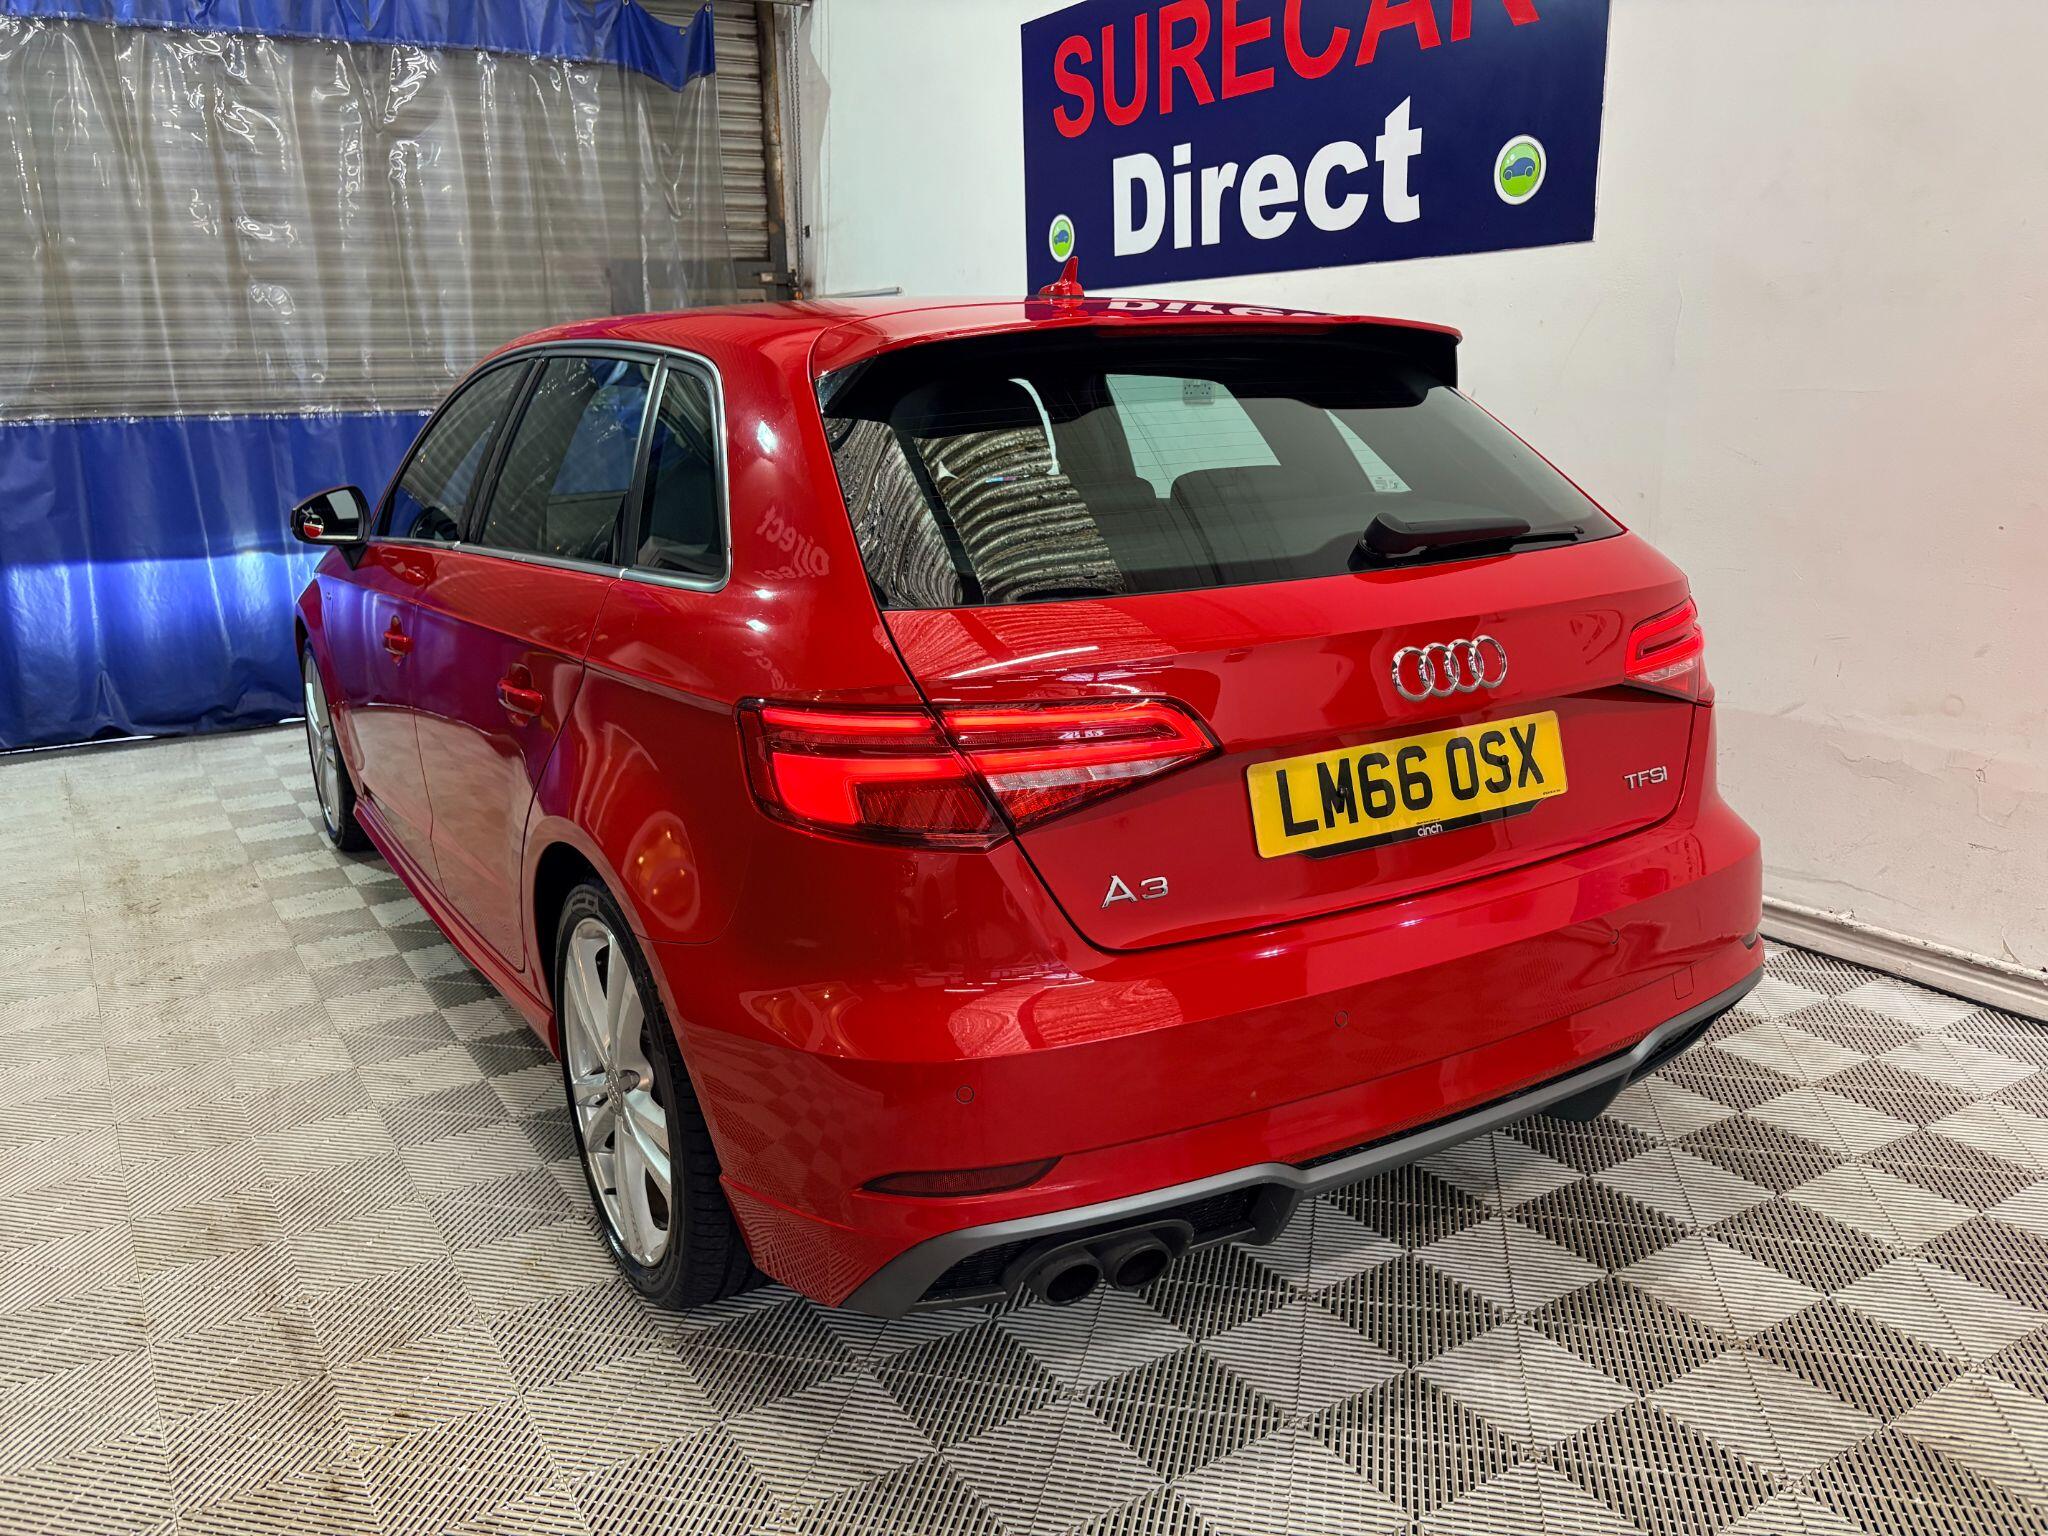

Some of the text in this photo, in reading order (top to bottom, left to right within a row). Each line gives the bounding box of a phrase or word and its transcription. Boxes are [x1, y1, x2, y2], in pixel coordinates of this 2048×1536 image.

[1113, 95, 1423, 257] Direct
[1276, 723, 1545, 837] LM66 OSX
[1623, 765, 1668, 790] TFSI
[1417, 822, 1444, 837] cinch
[1101, 874, 1169, 909] A3
